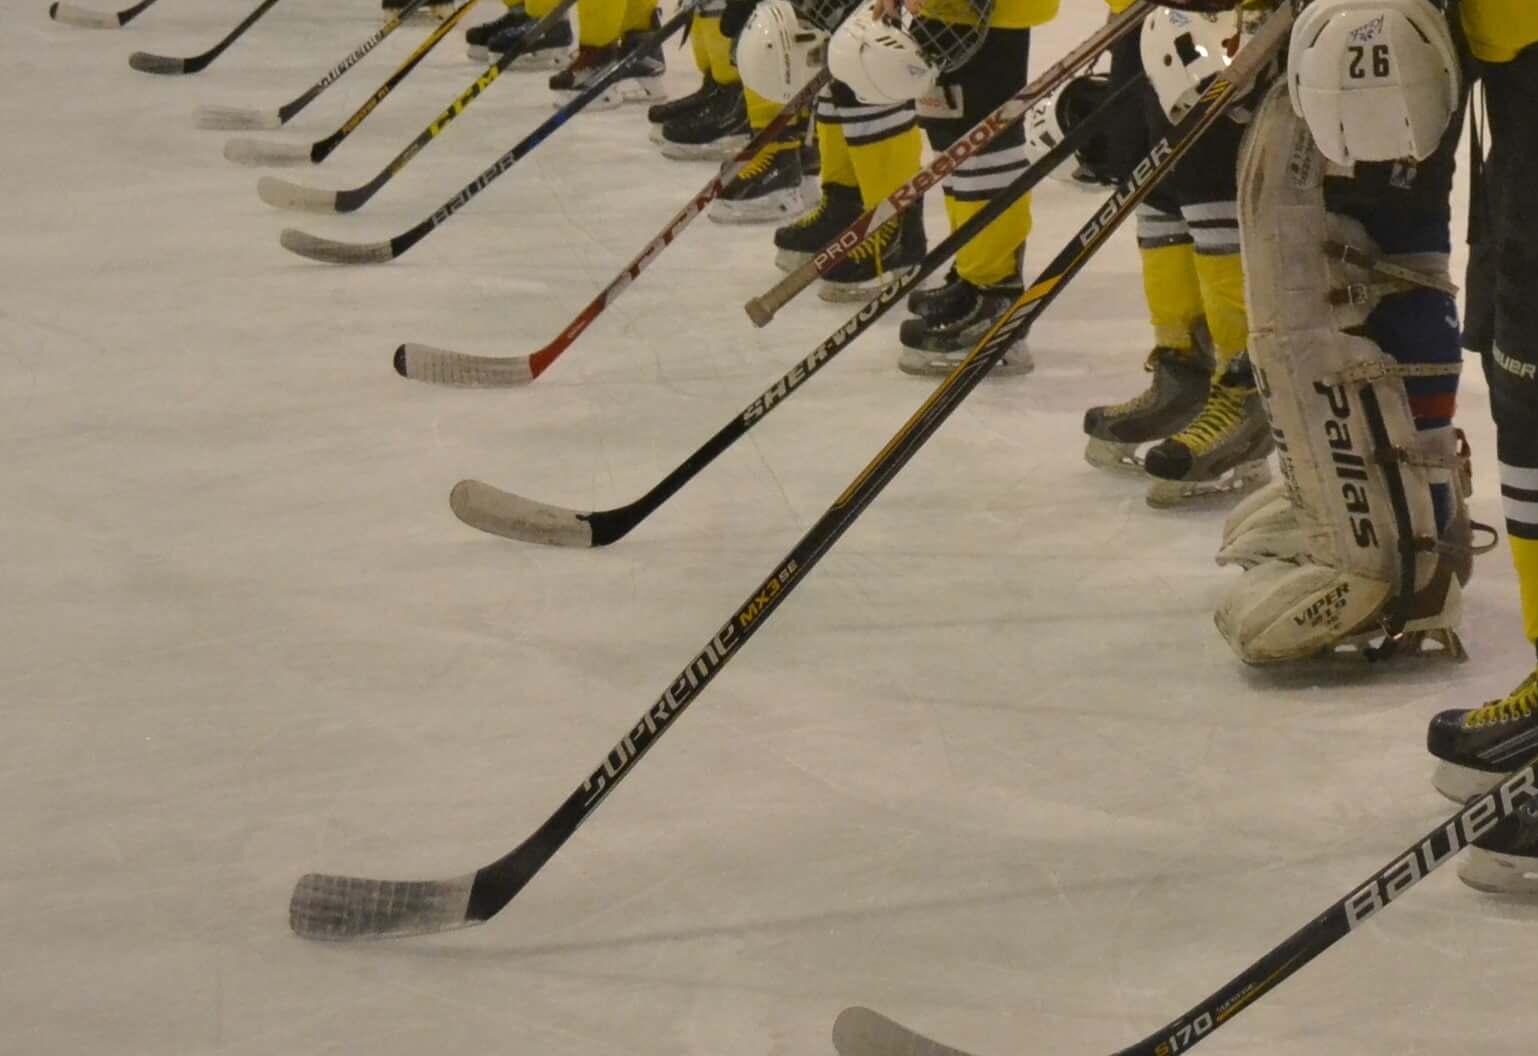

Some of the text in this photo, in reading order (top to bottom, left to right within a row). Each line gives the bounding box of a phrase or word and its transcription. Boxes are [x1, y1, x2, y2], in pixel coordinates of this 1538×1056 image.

[1079, 137, 1174, 250] BAUER
[813, 229, 860, 271] PRO
[742, 263, 923, 429] SHER-WOOD
[1312, 380, 1379, 550] Pallas
[738, 577, 781, 628] MX3
[1293, 581, 1351, 627] VIPER
